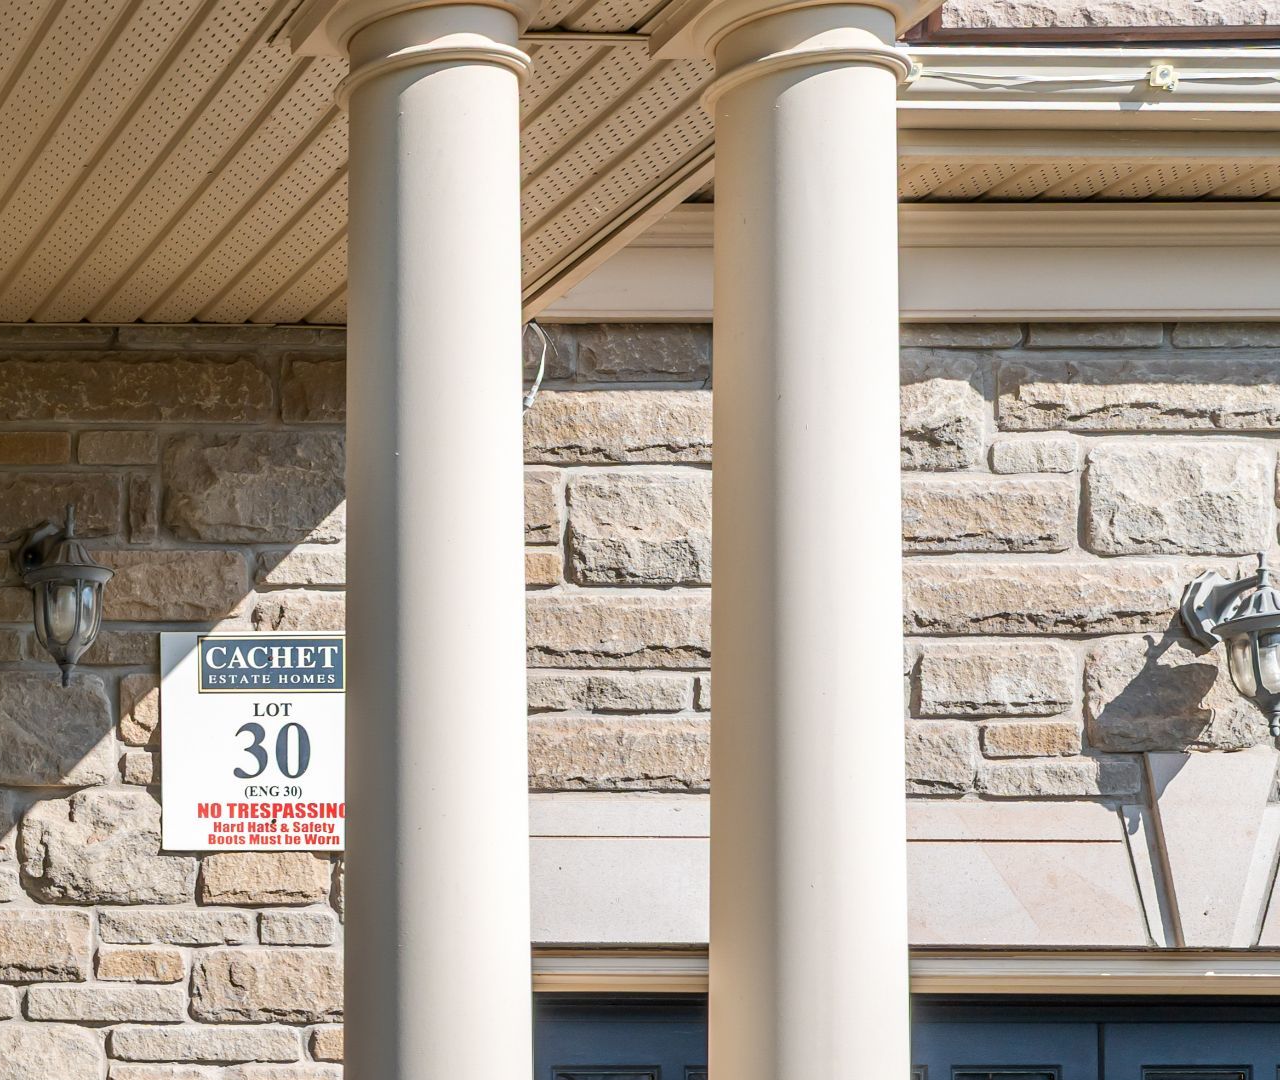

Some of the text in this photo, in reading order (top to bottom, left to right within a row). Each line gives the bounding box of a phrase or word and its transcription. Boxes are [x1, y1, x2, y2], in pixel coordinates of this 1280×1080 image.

[206, 646, 338, 669] CACHET
[208, 674, 336, 684] ESTATE HOMES
[253, 703, 292, 717] LOT
[233, 722, 311, 779] 30
[244, 785, 303, 798] (ENG 30)
[198, 803, 222, 818] NO
[213, 821, 335, 834] Hard Hats & Safety
[208, 834, 340, 845] Boots Must be Worn
